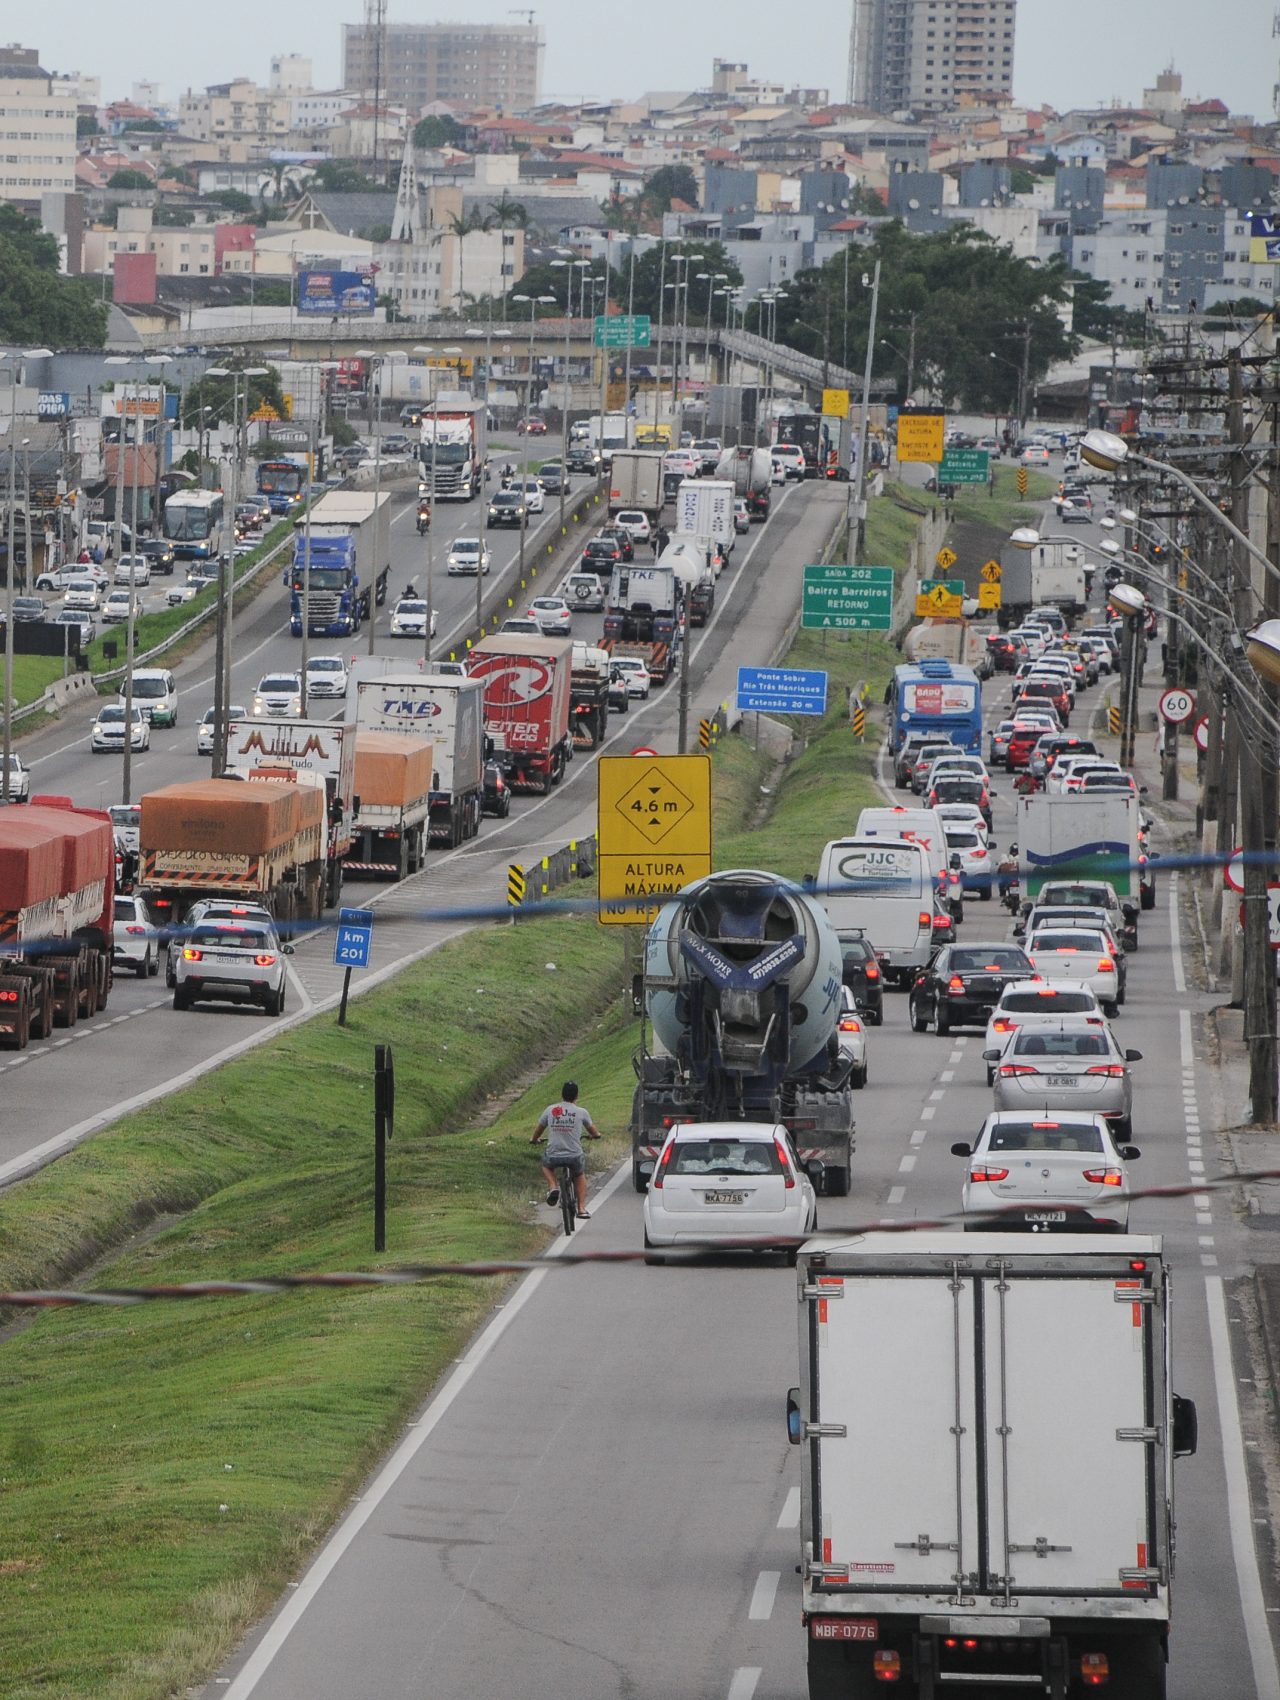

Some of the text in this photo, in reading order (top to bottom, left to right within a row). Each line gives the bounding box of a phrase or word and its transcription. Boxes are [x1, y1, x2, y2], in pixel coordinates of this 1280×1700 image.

[631, 571, 656, 580] TKE
[824, 568, 872, 579] SAÍDA 202
[807, 586, 888, 597] Bairro Barreiros
[827, 600, 869, 609] RETORNO
[823, 617, 831, 625] A
[835, 618, 857, 626] 500
[757, 673, 806, 682] Ponte Sobre
[759, 682, 776, 690] Três
[778, 684, 820, 693] Henriques
[383, 700, 431, 714] TKE
[748, 698, 787, 707] Extensão
[1166, 697, 1188, 711] 60
[484, 720, 540, 734] EITER
[512, 733, 538, 742] LOG
[291, 758, 313, 769] tudo
[663, 802, 678, 812] m
[867, 853, 895, 864] JJC
[625, 863, 685, 876] ALTURA
[624, 879, 683, 896] MÁXIMA
[344, 931, 364, 943] km
[686, 937, 708, 954] MAX
[340, 947, 363, 960] 201
[815, 1624, 875, 1638] MBF-0776
